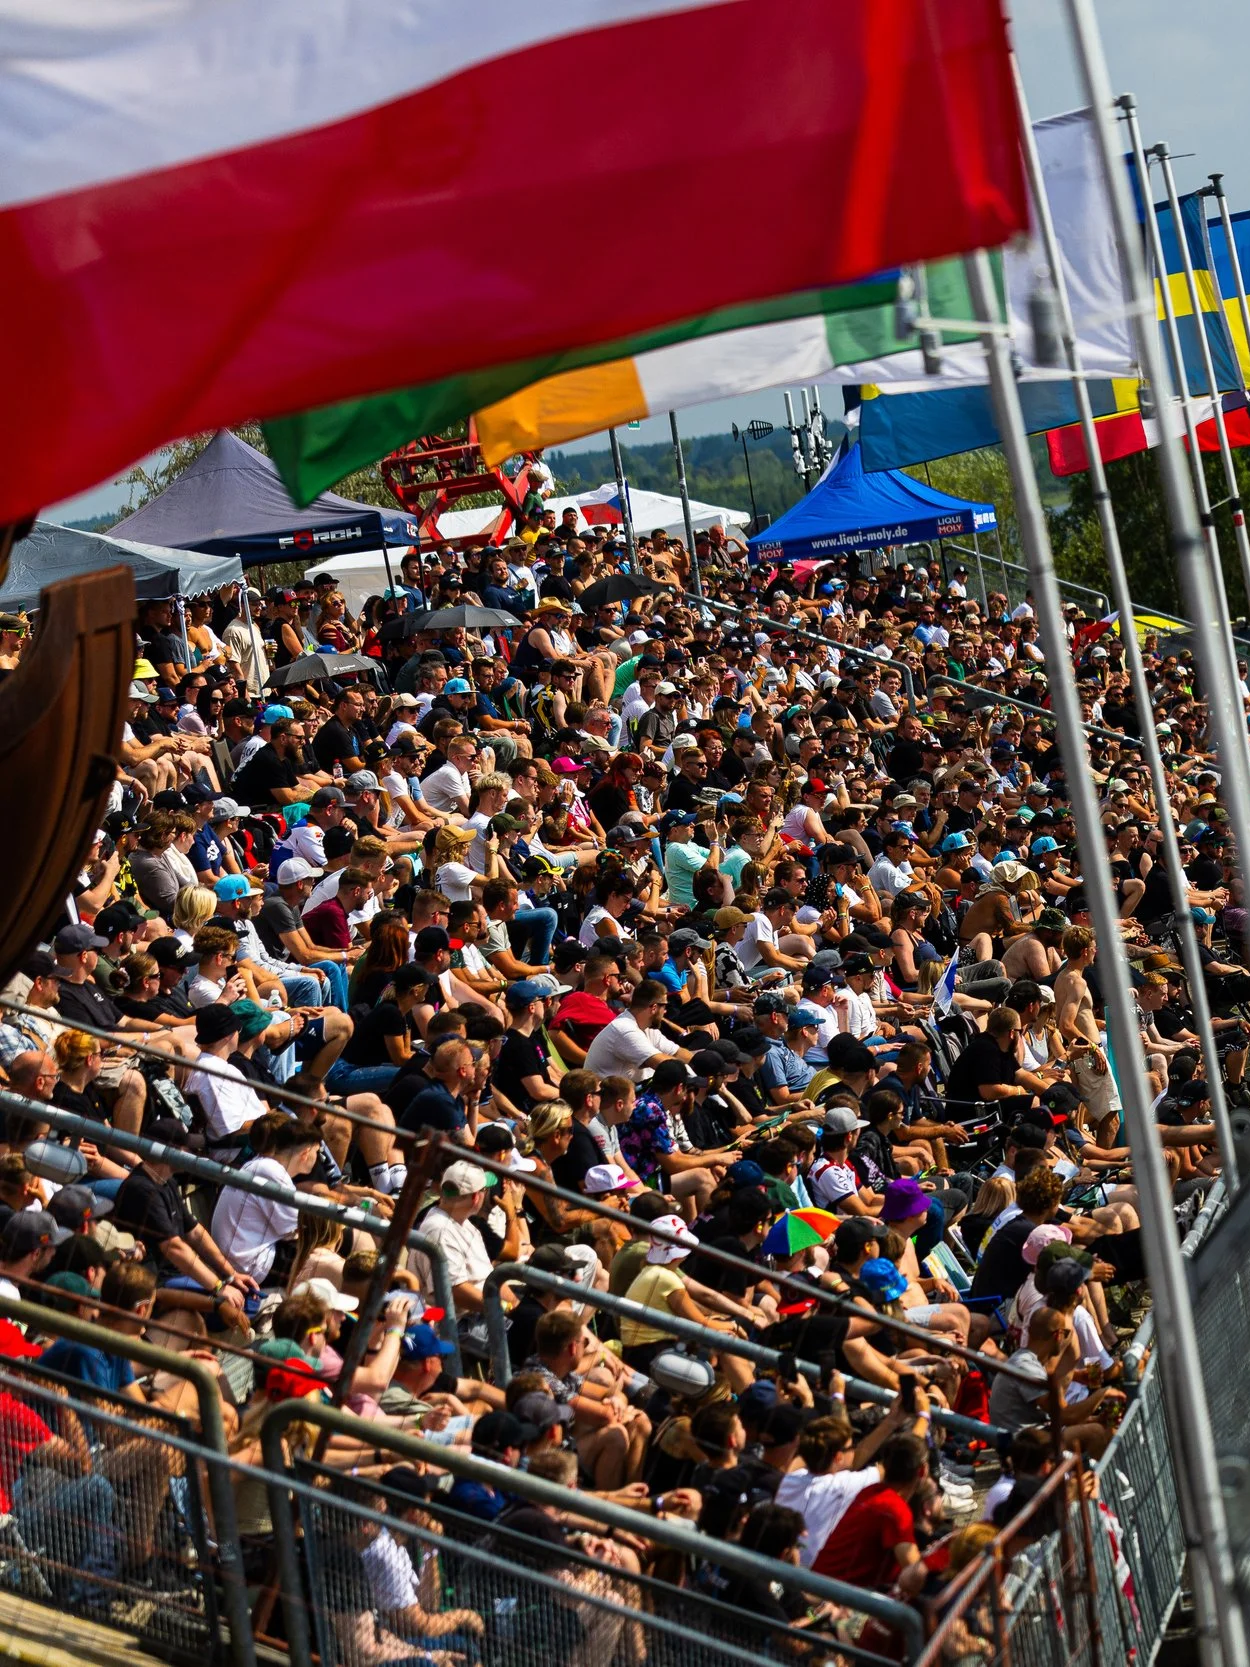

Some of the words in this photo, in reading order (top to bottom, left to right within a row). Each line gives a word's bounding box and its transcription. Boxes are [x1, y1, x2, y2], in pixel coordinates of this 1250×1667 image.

[937, 515, 961, 526] LIQUI
[938, 523, 963, 534] MOLY
[811, 527, 908, 549] www.liqui-moly.de
[757, 541, 782, 551] LIQUI
[758, 549, 784, 560] MOLY
